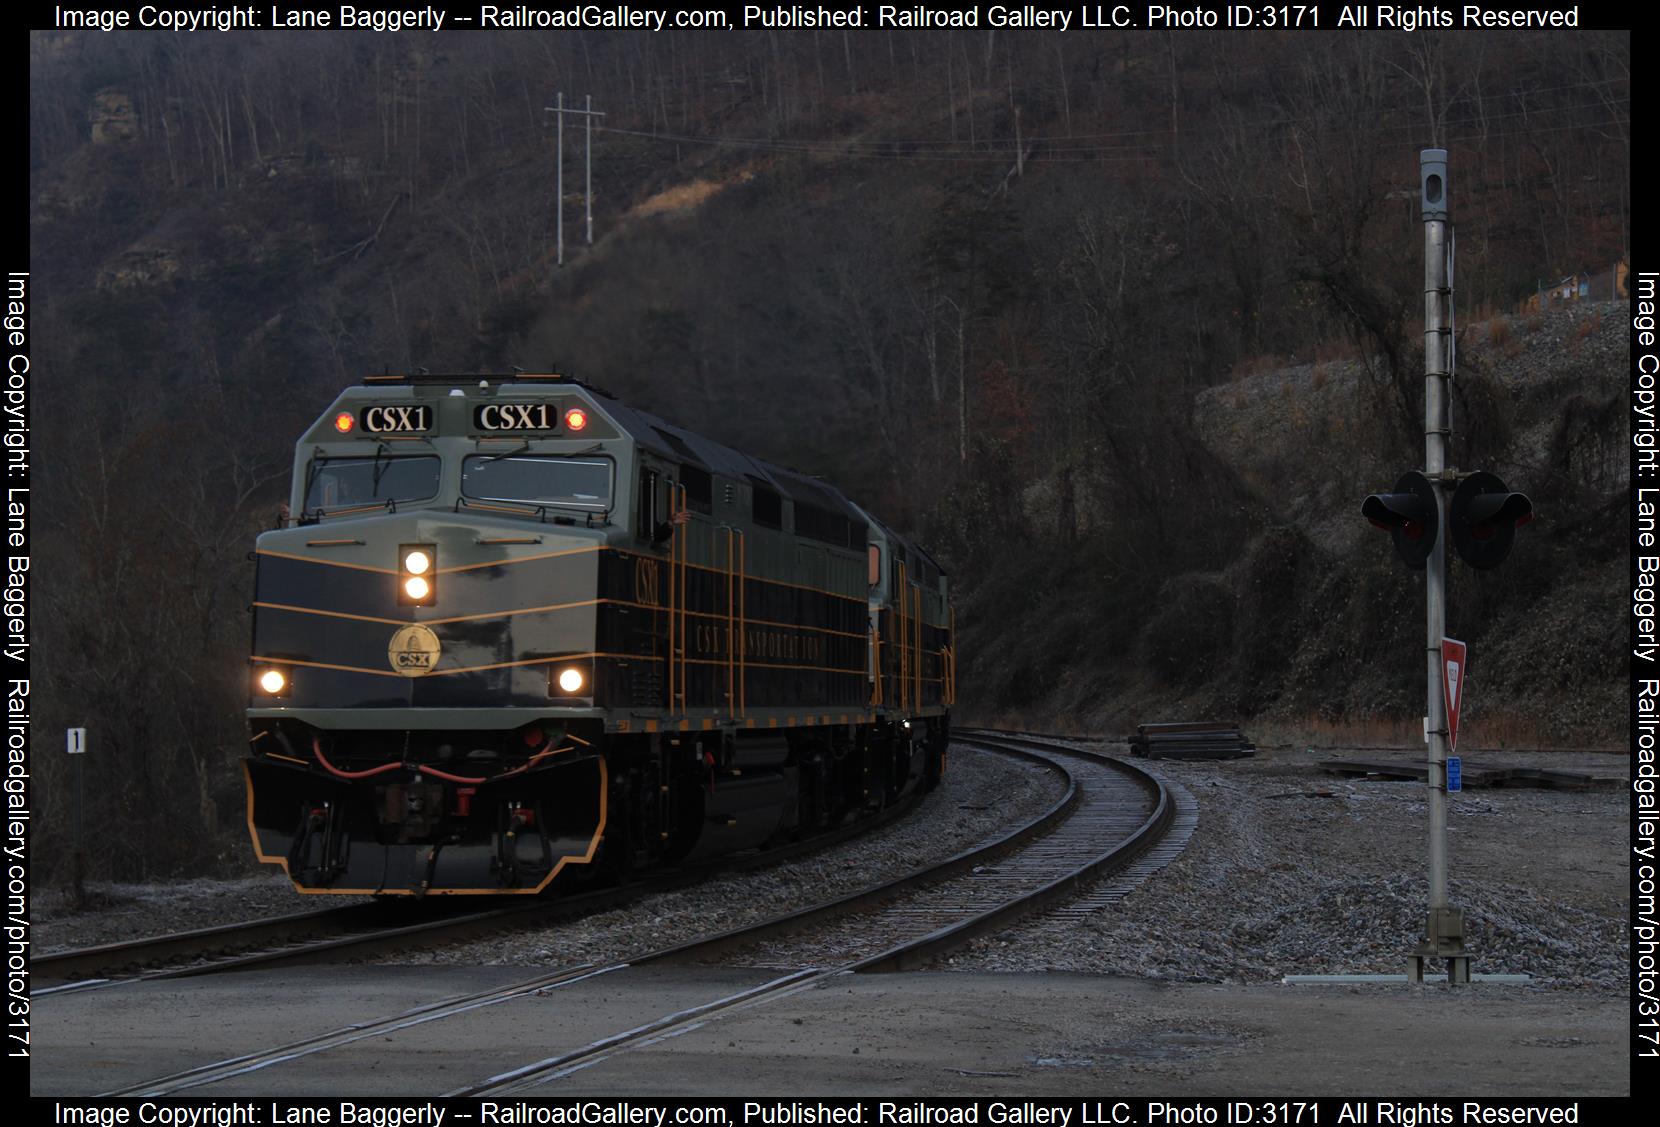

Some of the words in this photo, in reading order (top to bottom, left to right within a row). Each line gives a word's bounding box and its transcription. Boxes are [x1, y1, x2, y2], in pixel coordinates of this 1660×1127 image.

[367, 407, 427, 432] CSX1
[481, 405, 551, 429] CSX1
[635, 557, 659, 605] CSX1
[697, 624, 720, 655] CSX
[397, 652, 430, 667] CSX
[73, 731, 79, 751] 1
